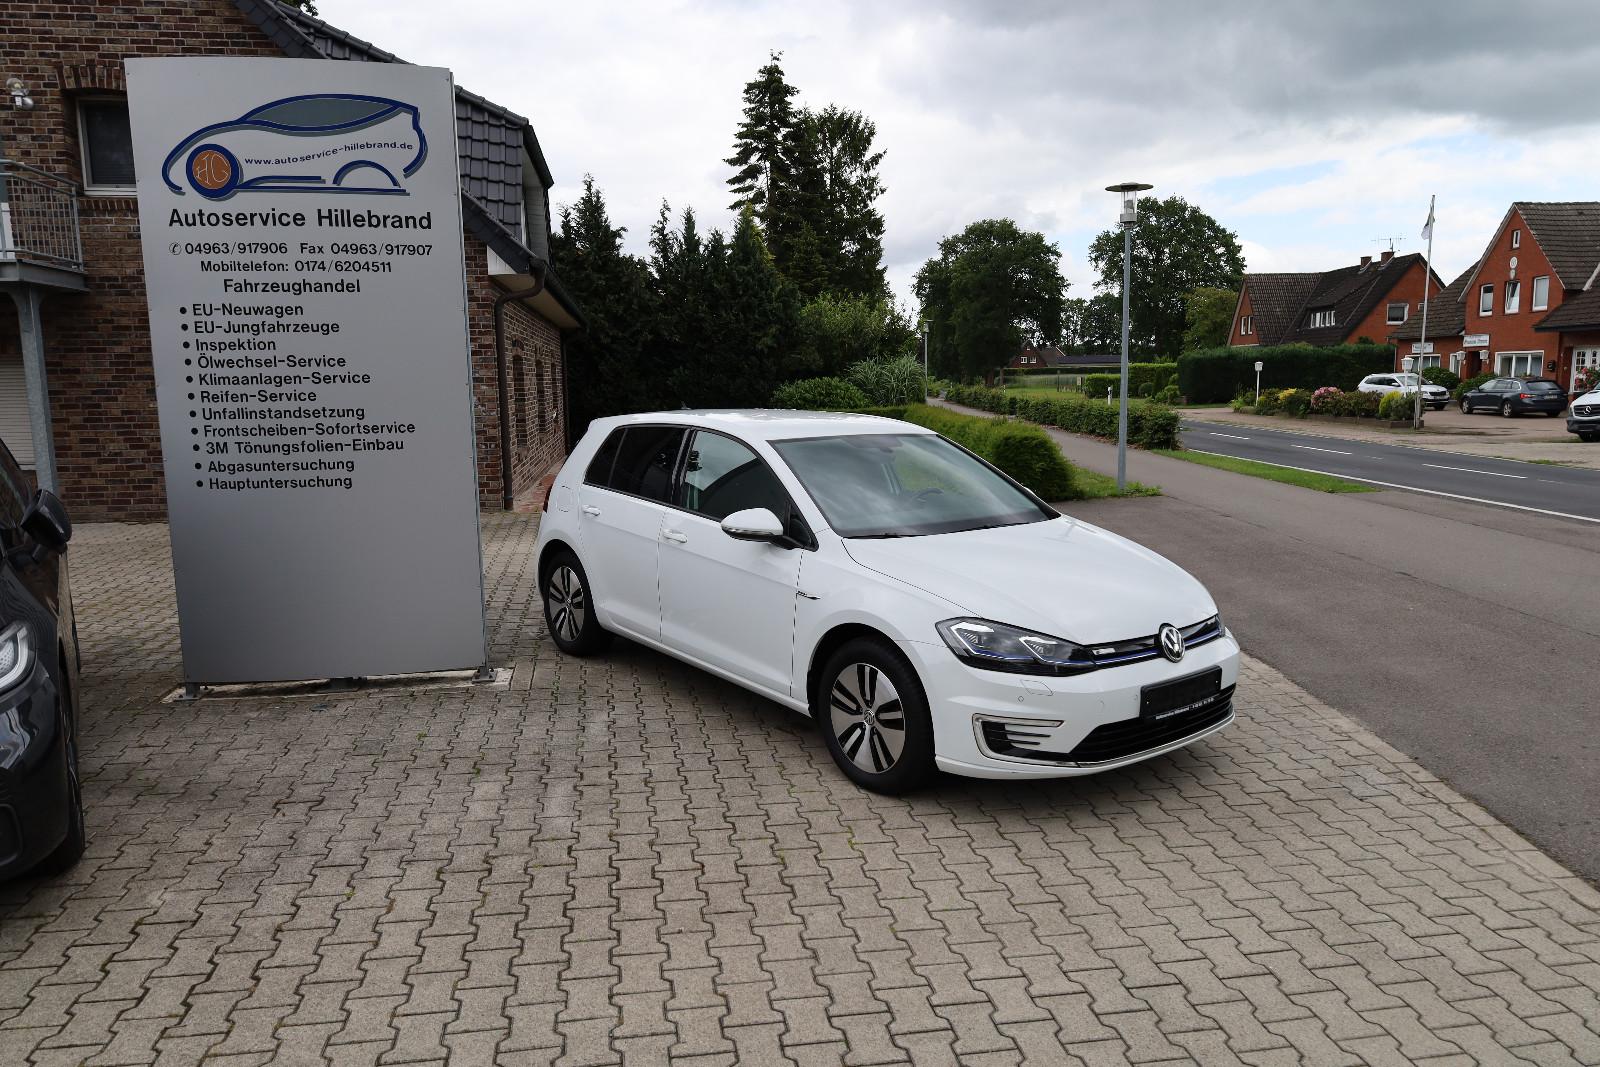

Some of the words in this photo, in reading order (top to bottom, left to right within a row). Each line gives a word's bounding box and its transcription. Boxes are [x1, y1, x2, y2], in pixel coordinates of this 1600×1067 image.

[244, 141, 414, 166] www.autoservice-hillebrand.de
[169, 208, 305, 227] Autoservice
[317, 209, 431, 229] Hillebrand
[185, 242, 287, 255] 04963/917906
[300, 243, 324, 254] Fax
[331, 243, 432, 255] 04963/917907
[201, 261, 288, 272] Mobiltelefon:
[295, 260, 391, 272] 0174/6204511
[224, 279, 360, 295] Fahrzeughandel
[193, 303, 303, 318] EU-Neuwagen
[194, 321, 339, 336] EU-Jungfahrzeuge
[196, 338, 276, 353] Inspektion
[198, 353, 346, 368] Ölwechsel-Service
[199, 372, 370, 387] Klimaanlagen-Service
[201, 389, 316, 403] Reifen-Service
[202, 407, 364, 420] Unfallinstandsetzung
[204, 421, 415, 437] Frontscheiben-Sofortservice
[206, 442, 228, 454] 3M
[234, 439, 404, 455] Tönungsfolien-Einbau
[208, 459, 354, 475] Abgasuntersuchung
[209, 476, 352, 491] Hauptuntersuchung
